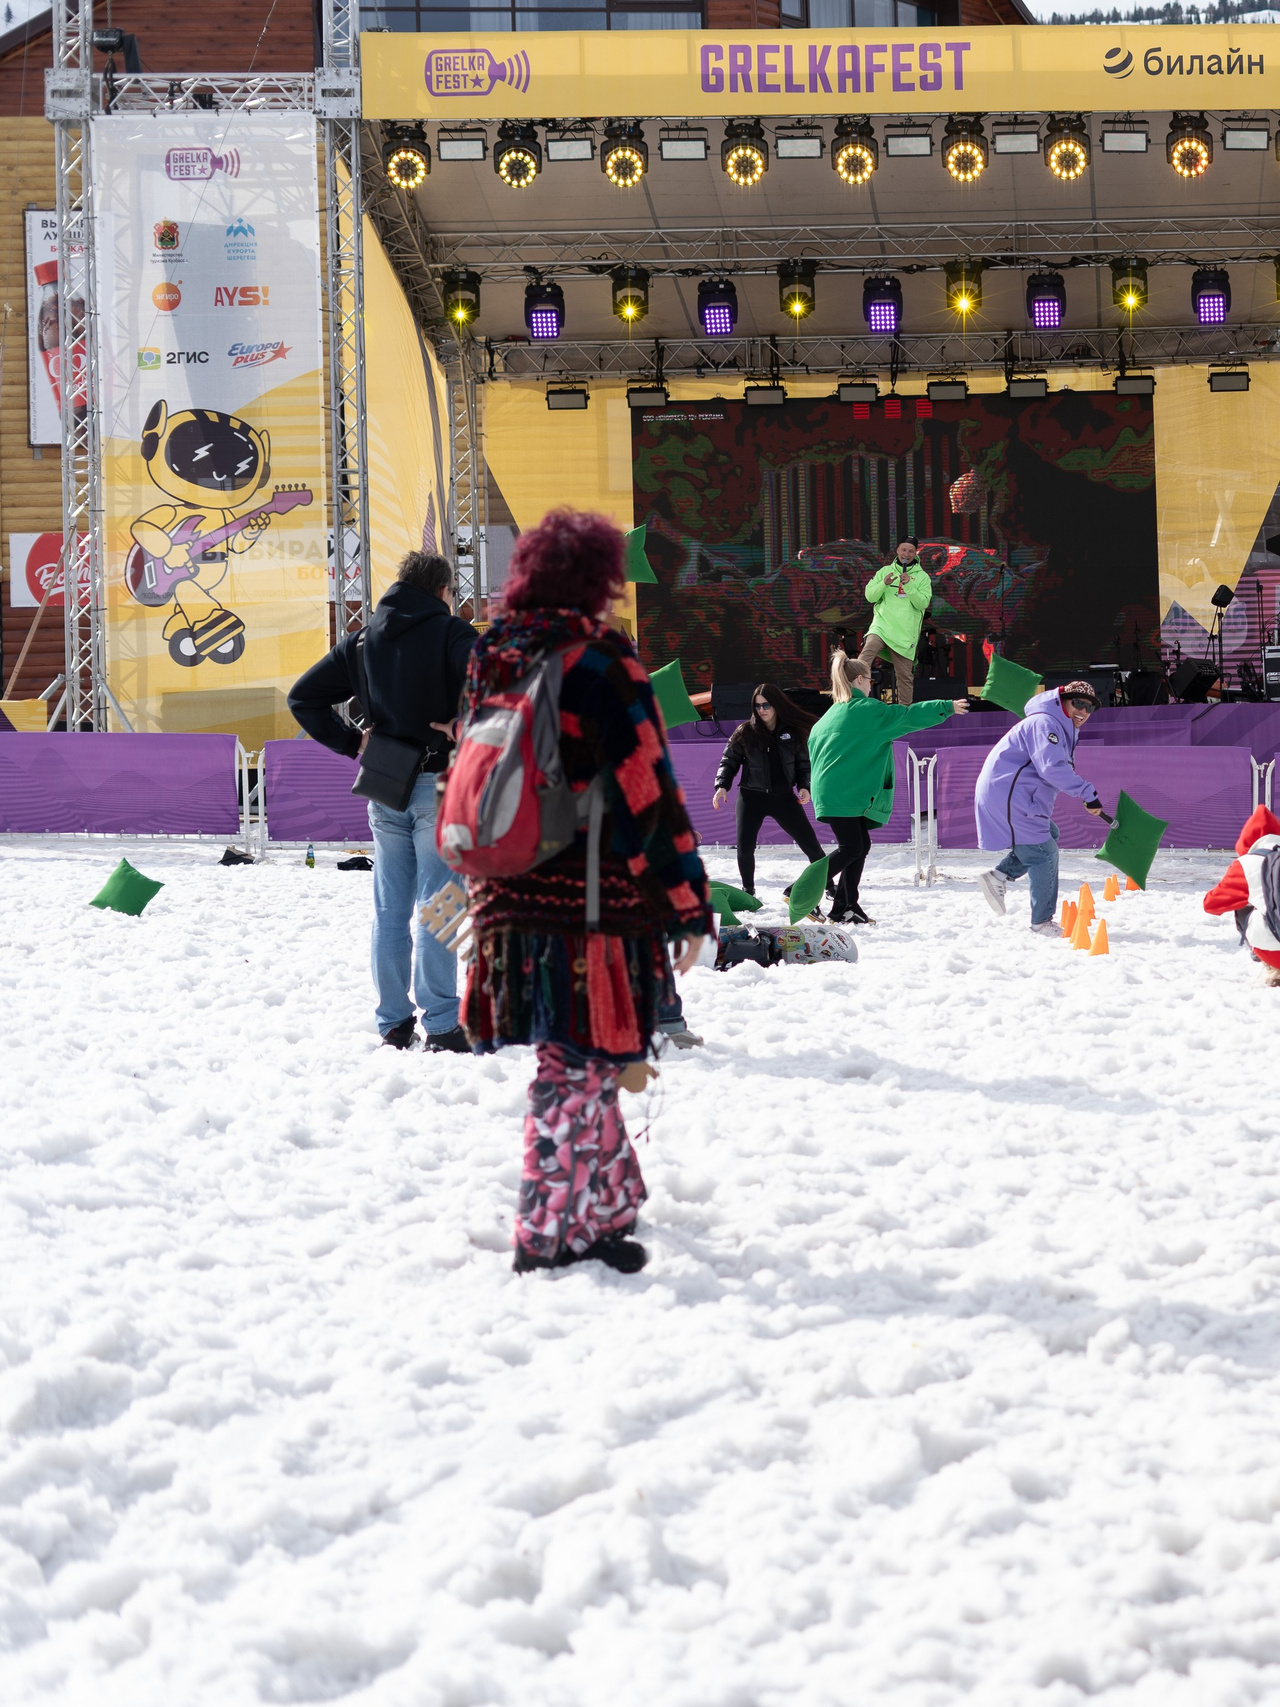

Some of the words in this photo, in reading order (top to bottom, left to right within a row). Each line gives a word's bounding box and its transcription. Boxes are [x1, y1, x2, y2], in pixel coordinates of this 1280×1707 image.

[435, 55, 485, 71] GRELKA
[700, 42, 971, 93] GRELKAFEST
[1143, 46, 1264, 76] билайн
[435, 74, 469, 89] FEST
[172, 152, 208, 163] GRELKA
[173, 165, 197, 176] FEST
[214, 286, 270, 307] AYS!
[166, 351, 210, 364] 2ГИС
